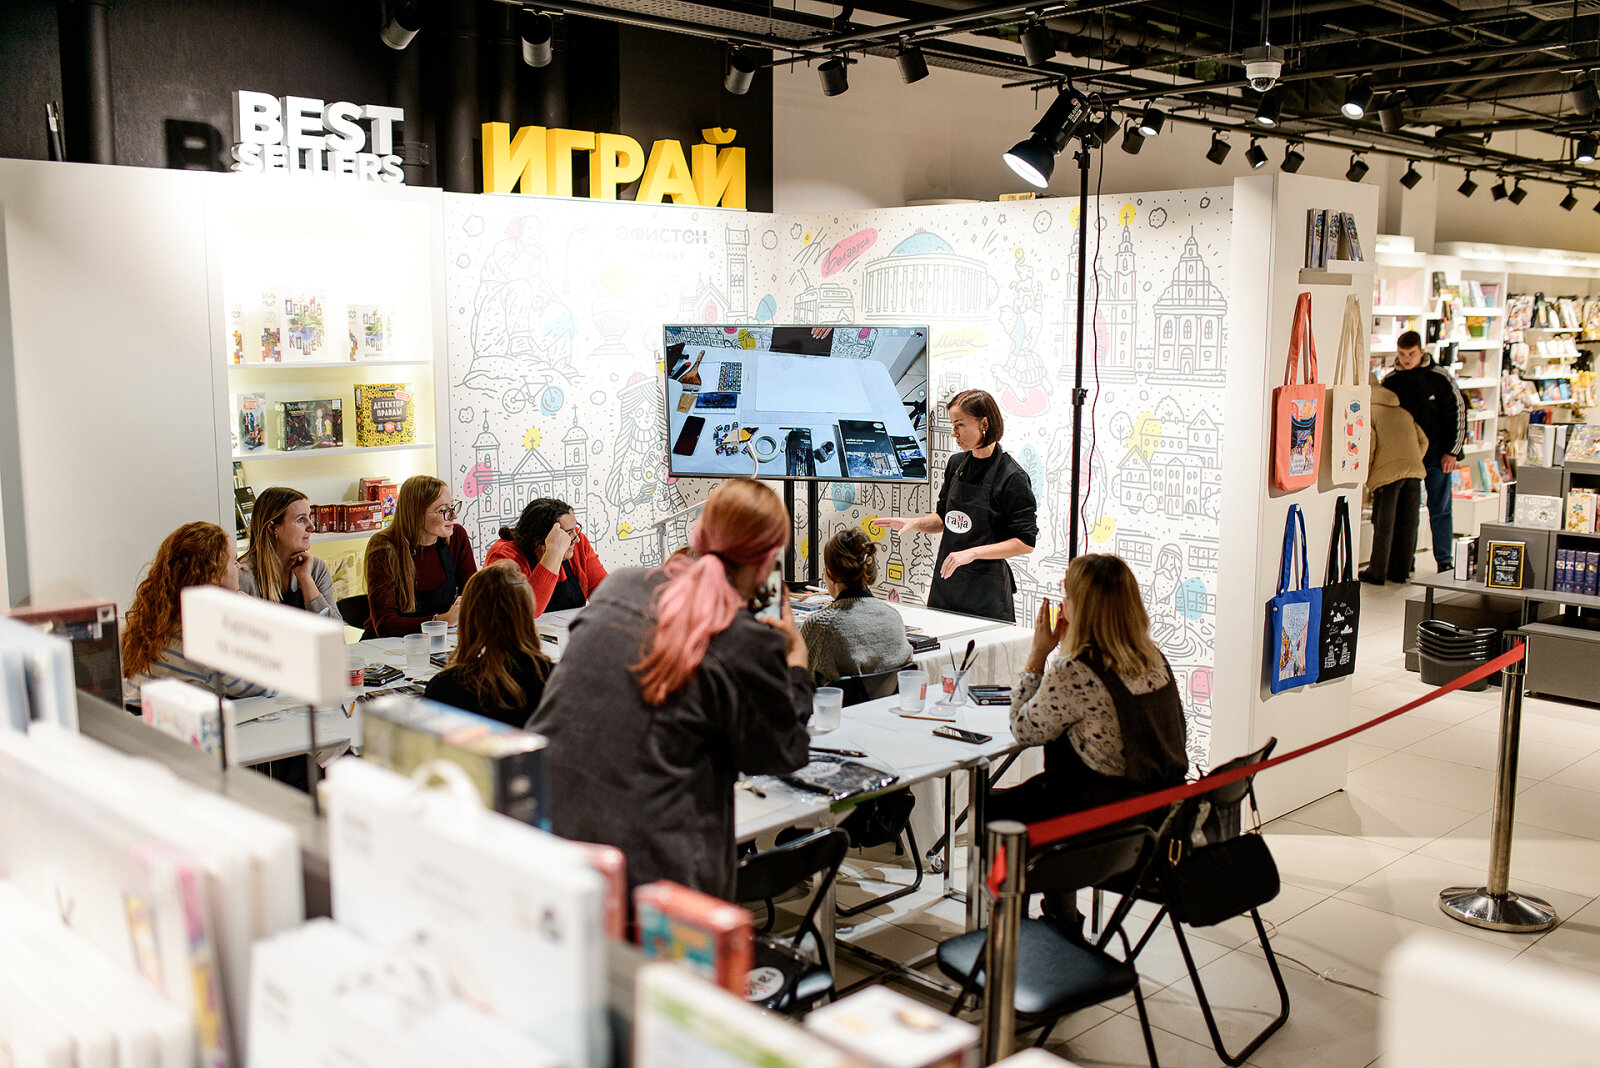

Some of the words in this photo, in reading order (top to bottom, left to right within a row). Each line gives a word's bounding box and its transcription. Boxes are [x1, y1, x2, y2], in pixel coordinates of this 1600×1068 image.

[232, 89, 405, 156] BEST
[231, 142, 405, 184] SELLERS
[481, 121, 747, 210] ИГРАЙ
